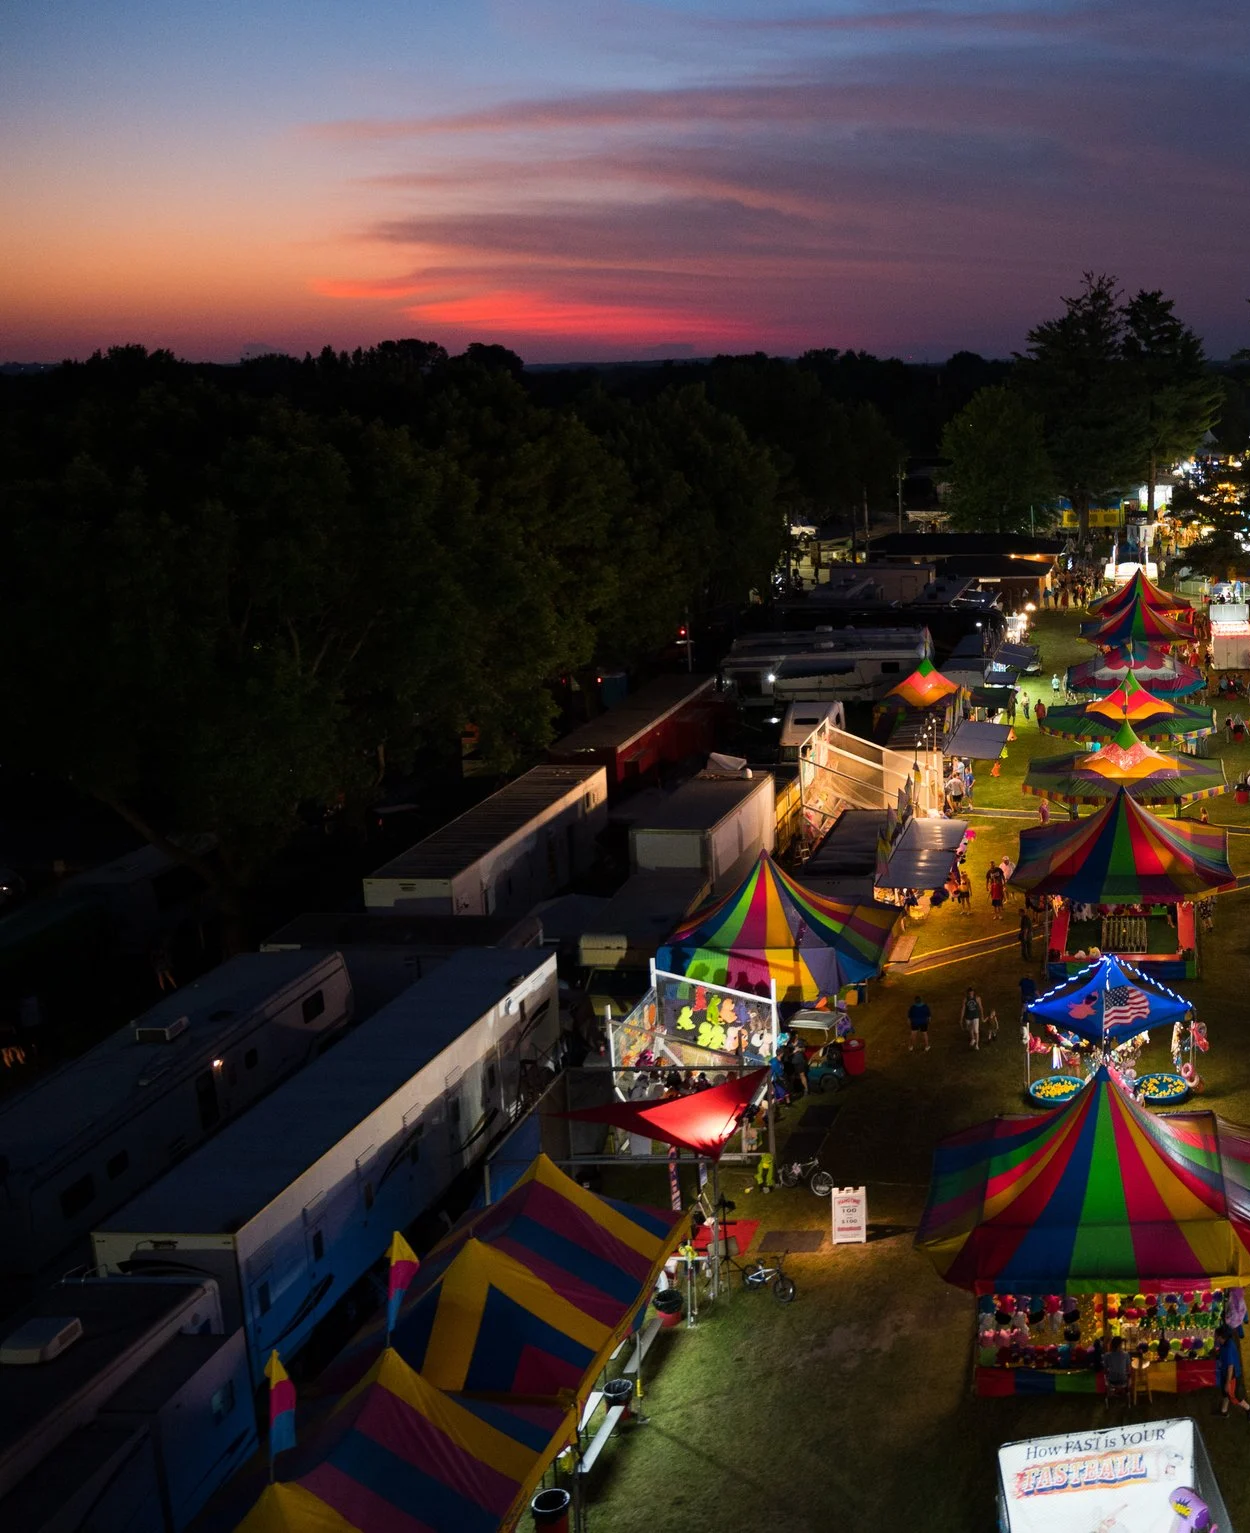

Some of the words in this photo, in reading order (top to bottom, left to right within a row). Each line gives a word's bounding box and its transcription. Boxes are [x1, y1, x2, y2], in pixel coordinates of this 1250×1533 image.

[1025, 1445, 1062, 1460] How
[1065, 1436, 1101, 1454] FAST
[1104, 1435, 1117, 1448] is
[1120, 1428, 1166, 1446] YOUR
[1022, 1453, 1147, 1496] FASTBALL
